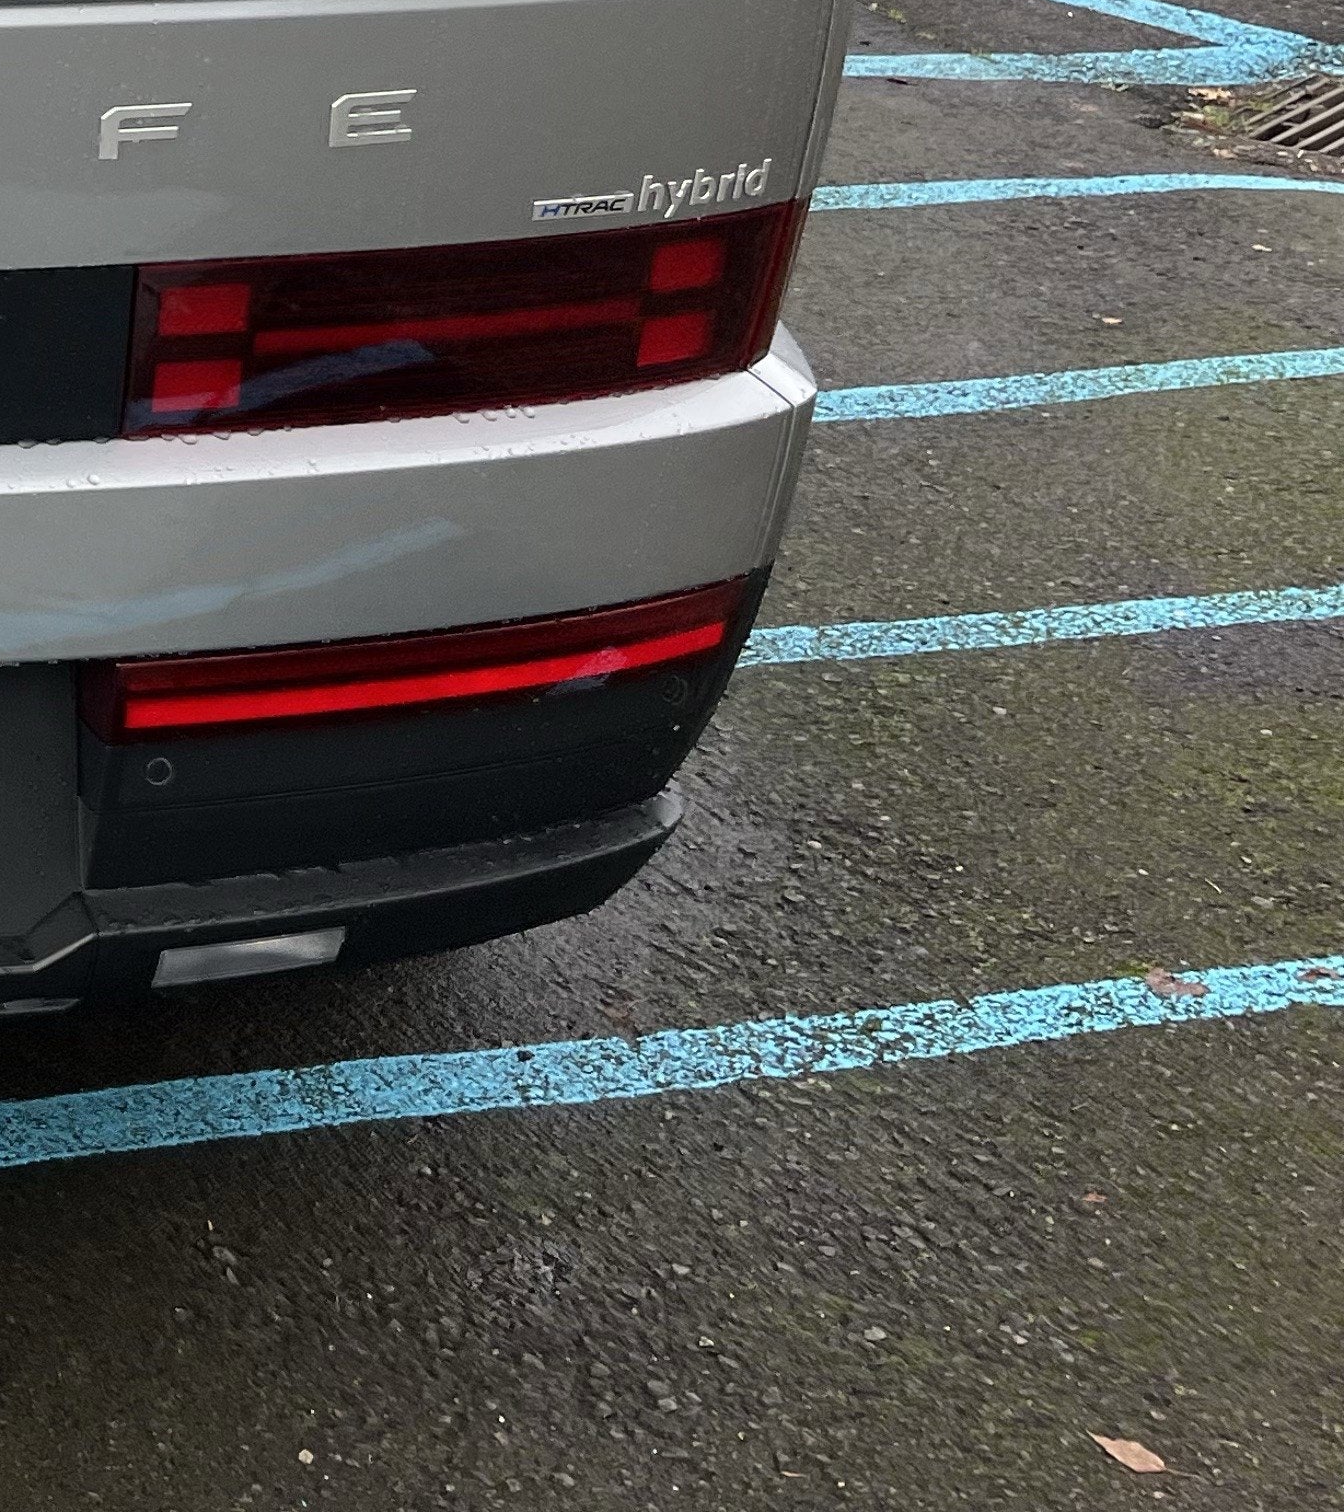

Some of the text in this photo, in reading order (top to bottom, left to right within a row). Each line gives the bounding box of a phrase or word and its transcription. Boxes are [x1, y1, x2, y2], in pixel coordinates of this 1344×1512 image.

[99, 88, 420, 162] FE
[539, 197, 627, 217] HTRAC
[637, 158, 772, 218] hybrid
